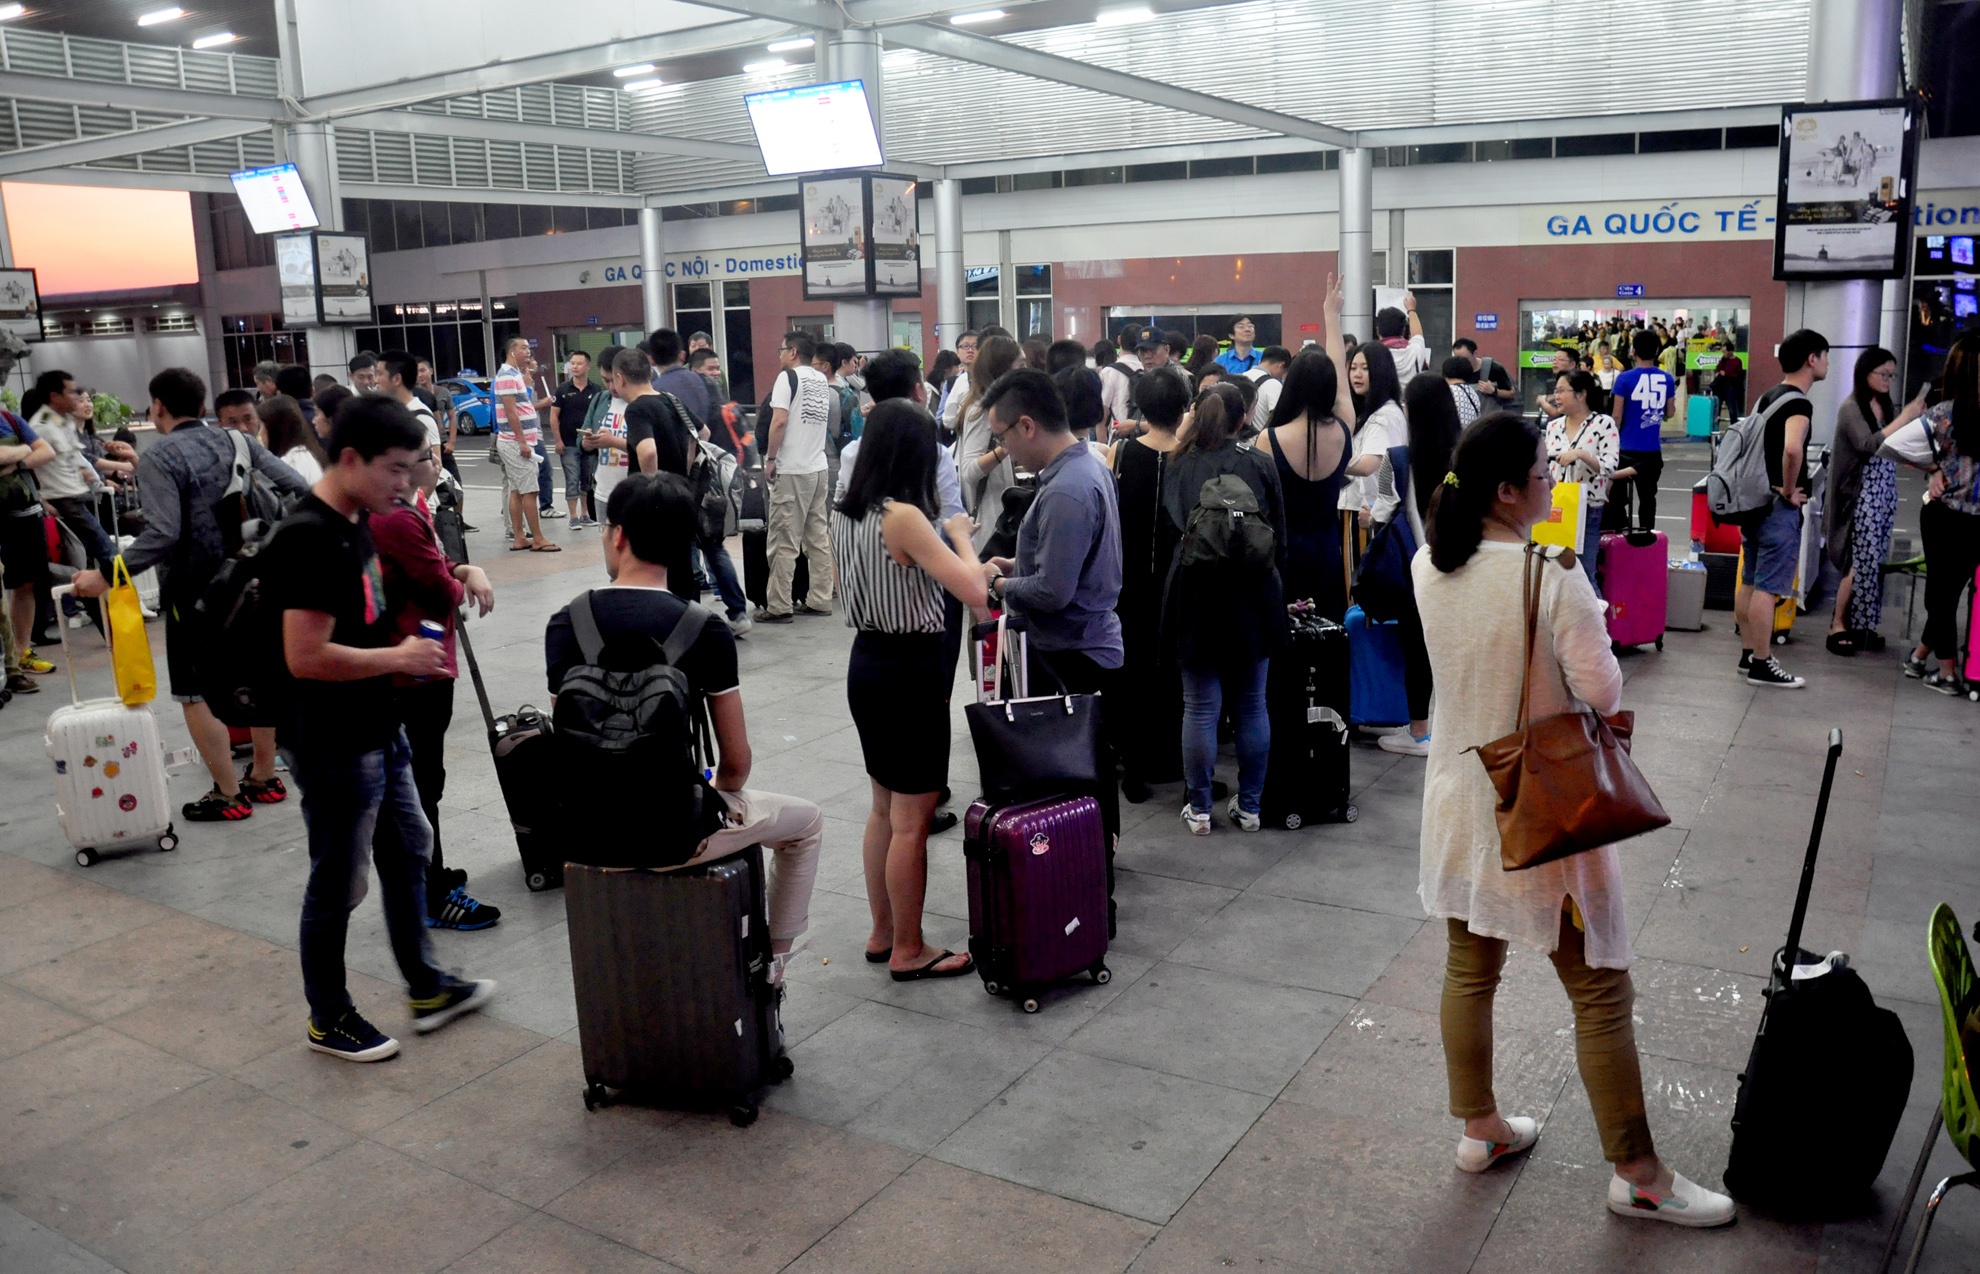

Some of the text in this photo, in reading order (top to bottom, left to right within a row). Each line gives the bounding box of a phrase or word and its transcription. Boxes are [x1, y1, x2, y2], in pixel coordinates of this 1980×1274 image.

[1546, 215, 1592, 236] GA
[1604, 202, 1700, 234] QUỐC
[1715, 200, 1762, 231] TẾ
[605, 267, 627, 282] GA
[631, 264, 676, 280] QC
[682, 256, 709, 279] NỘI
[1635, 286, 1642, 295] 4
[1631, 373, 1667, 409] 45
